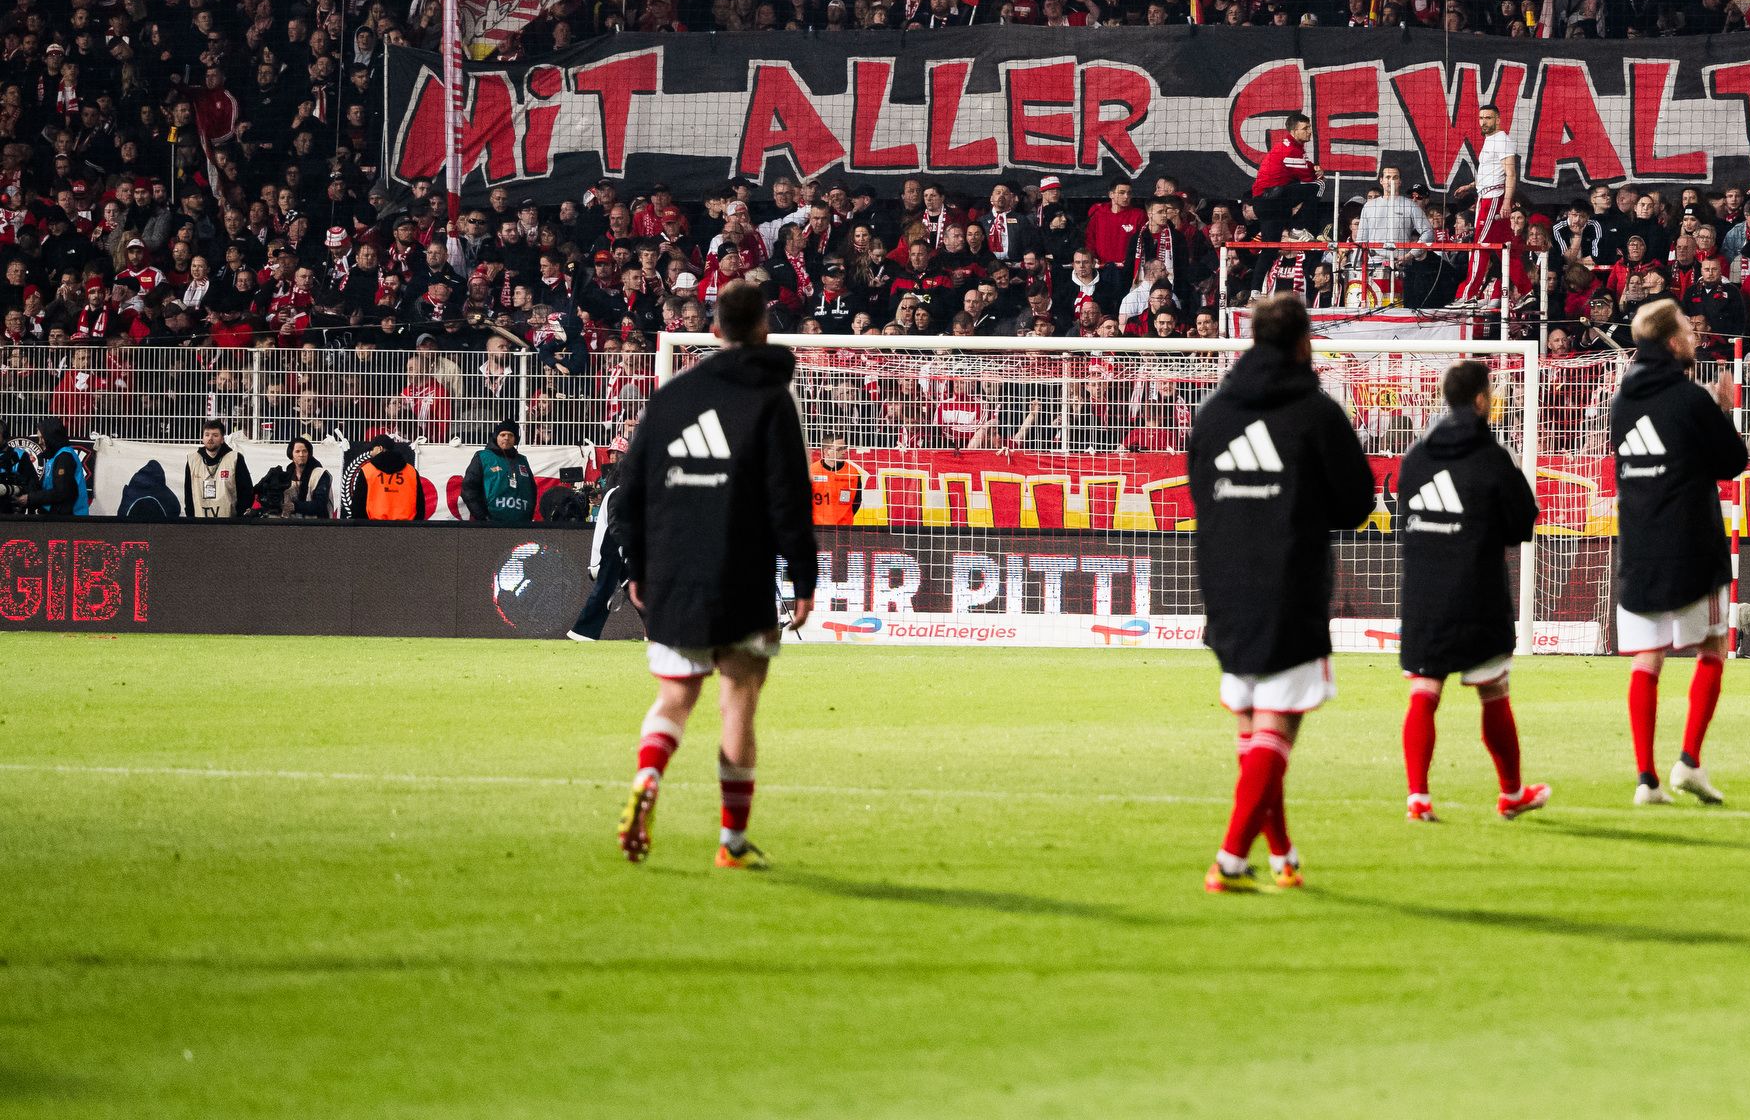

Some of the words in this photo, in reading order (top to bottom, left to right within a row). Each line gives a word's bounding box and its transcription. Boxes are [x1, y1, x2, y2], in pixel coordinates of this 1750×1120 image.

[728, 54, 1162, 185] ALLER
[377, 472, 405, 486] 175
[495, 496, 528, 511] HOST
[813, 492, 831, 506] 91
[202, 506, 221, 518] TV
[776, 550, 922, 613] HR
[886, 620, 1017, 643] TotalEnergies
